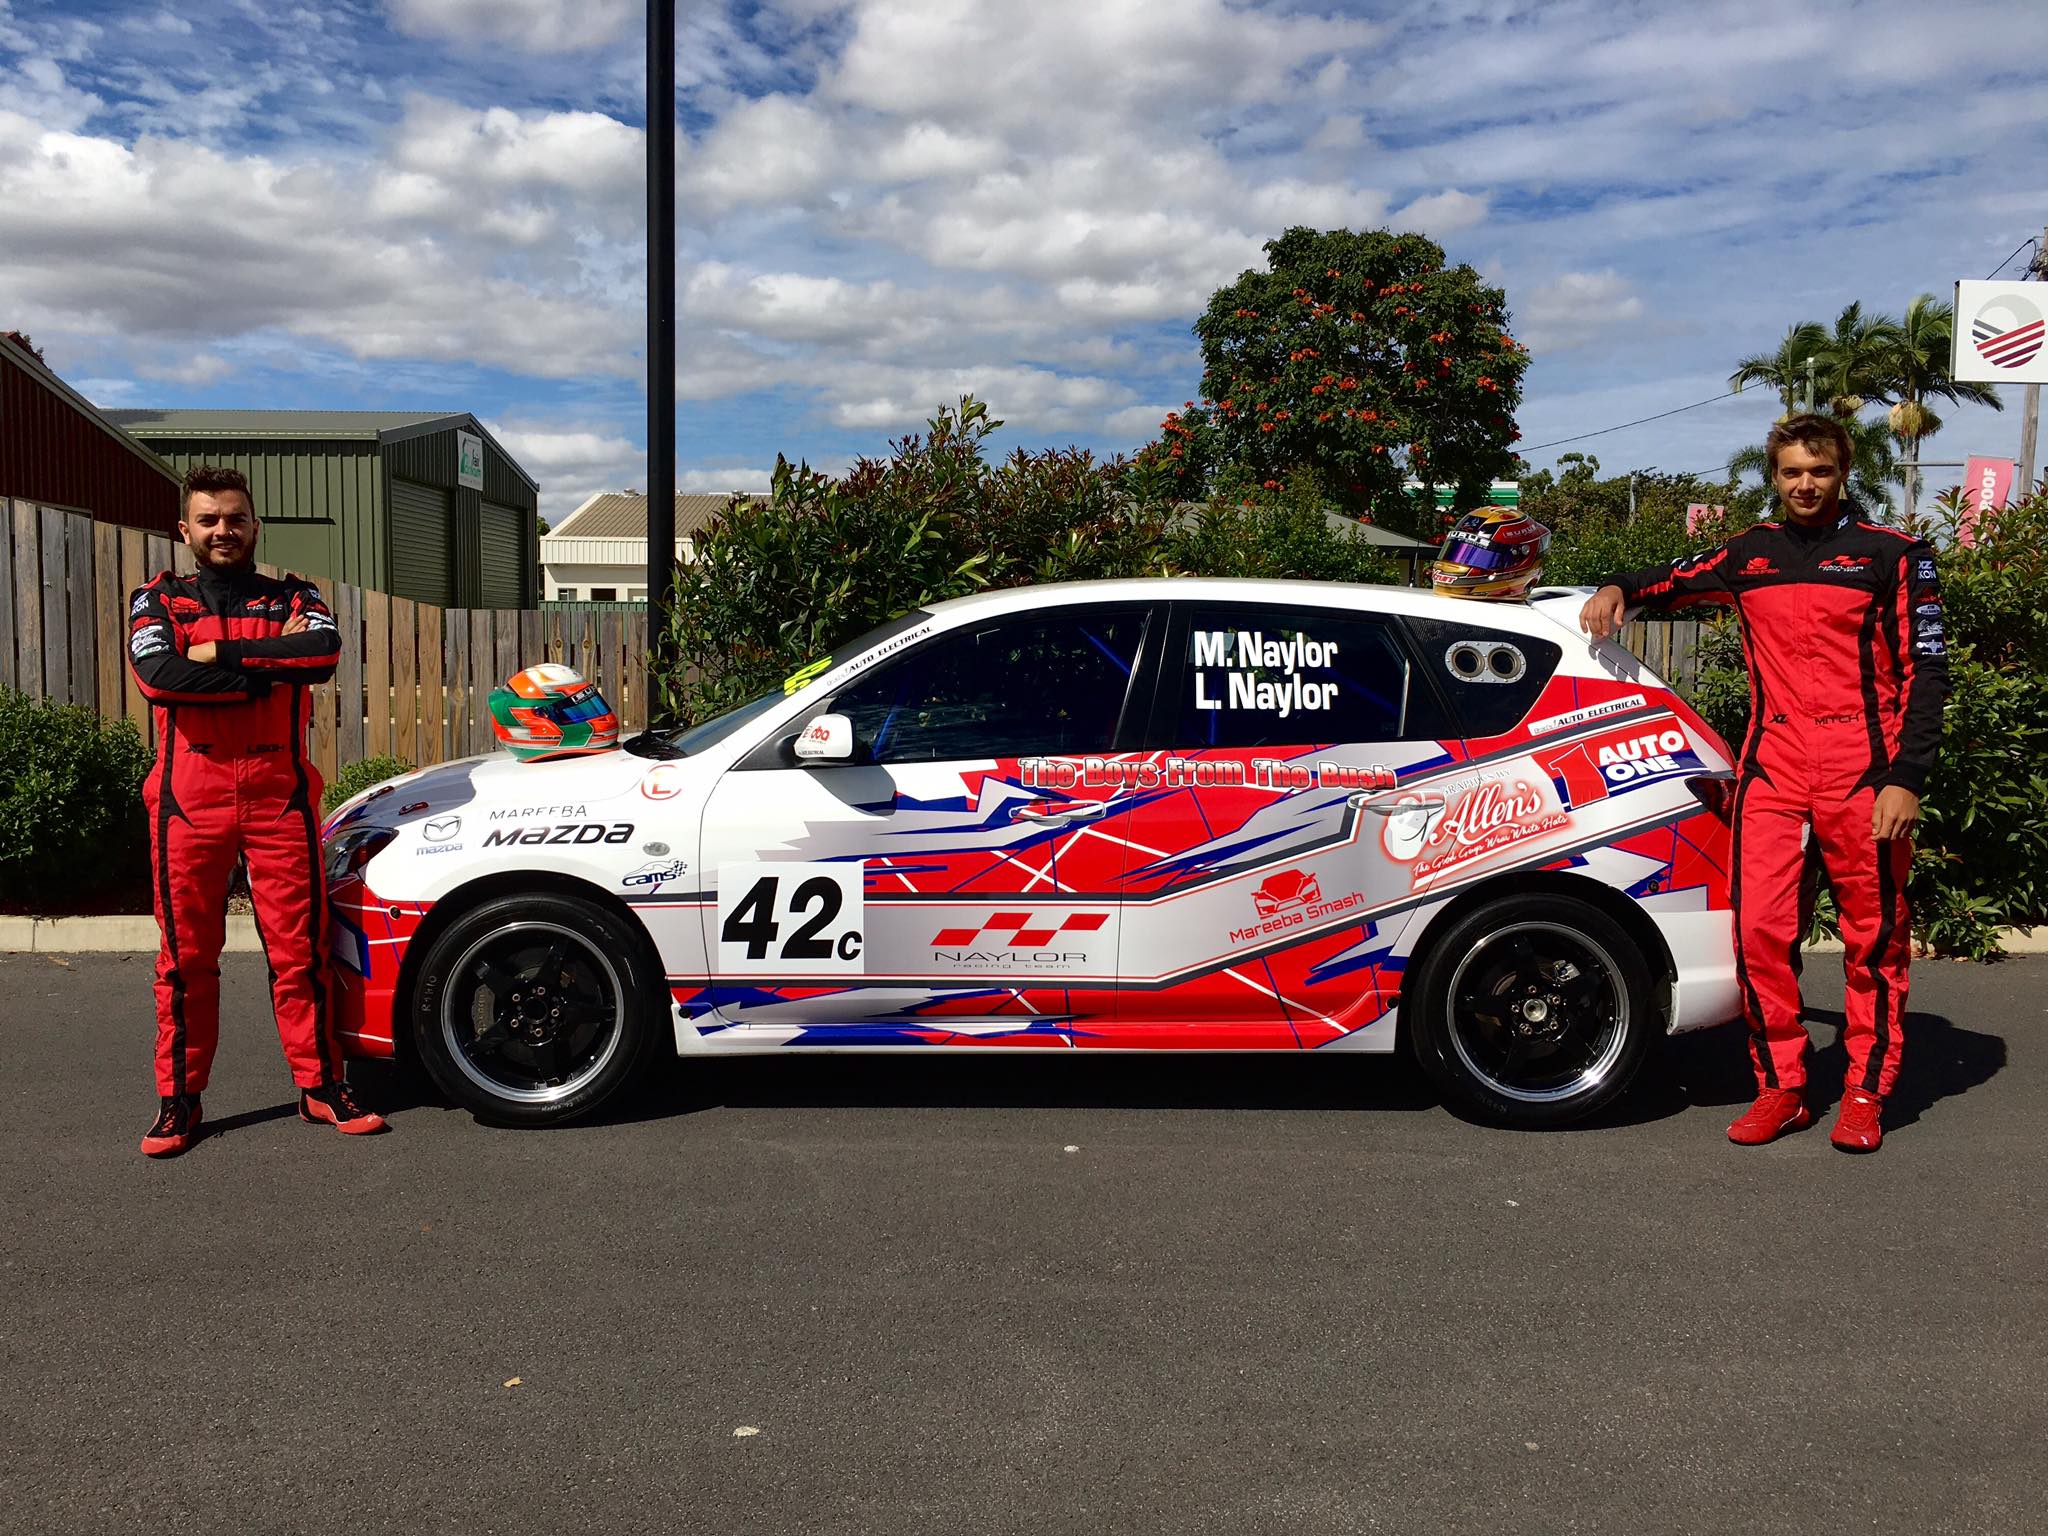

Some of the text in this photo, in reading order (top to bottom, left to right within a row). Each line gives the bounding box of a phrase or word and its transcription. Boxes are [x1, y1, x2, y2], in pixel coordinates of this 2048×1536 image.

[849, 626, 933, 673] AUTO ELECTRICAL
[1228, 672, 1339, 718] Naylor
[1558, 713, 1584, 727] AUTO
[1588, 698, 1643, 718] ELECTRICAL
[1599, 730, 1685, 767] AUTO
[1605, 754, 1681, 782] ONE
[1019, 757, 1397, 791] The Boys From The Bush
[1430, 782, 1541, 847] Allen's
[1413, 861, 1430, 876] The
[1542, 815, 1568, 830] Hats
[1229, 892, 1365, 943] Mareeba Smash
[934, 952, 1087, 962] NAYLOR
